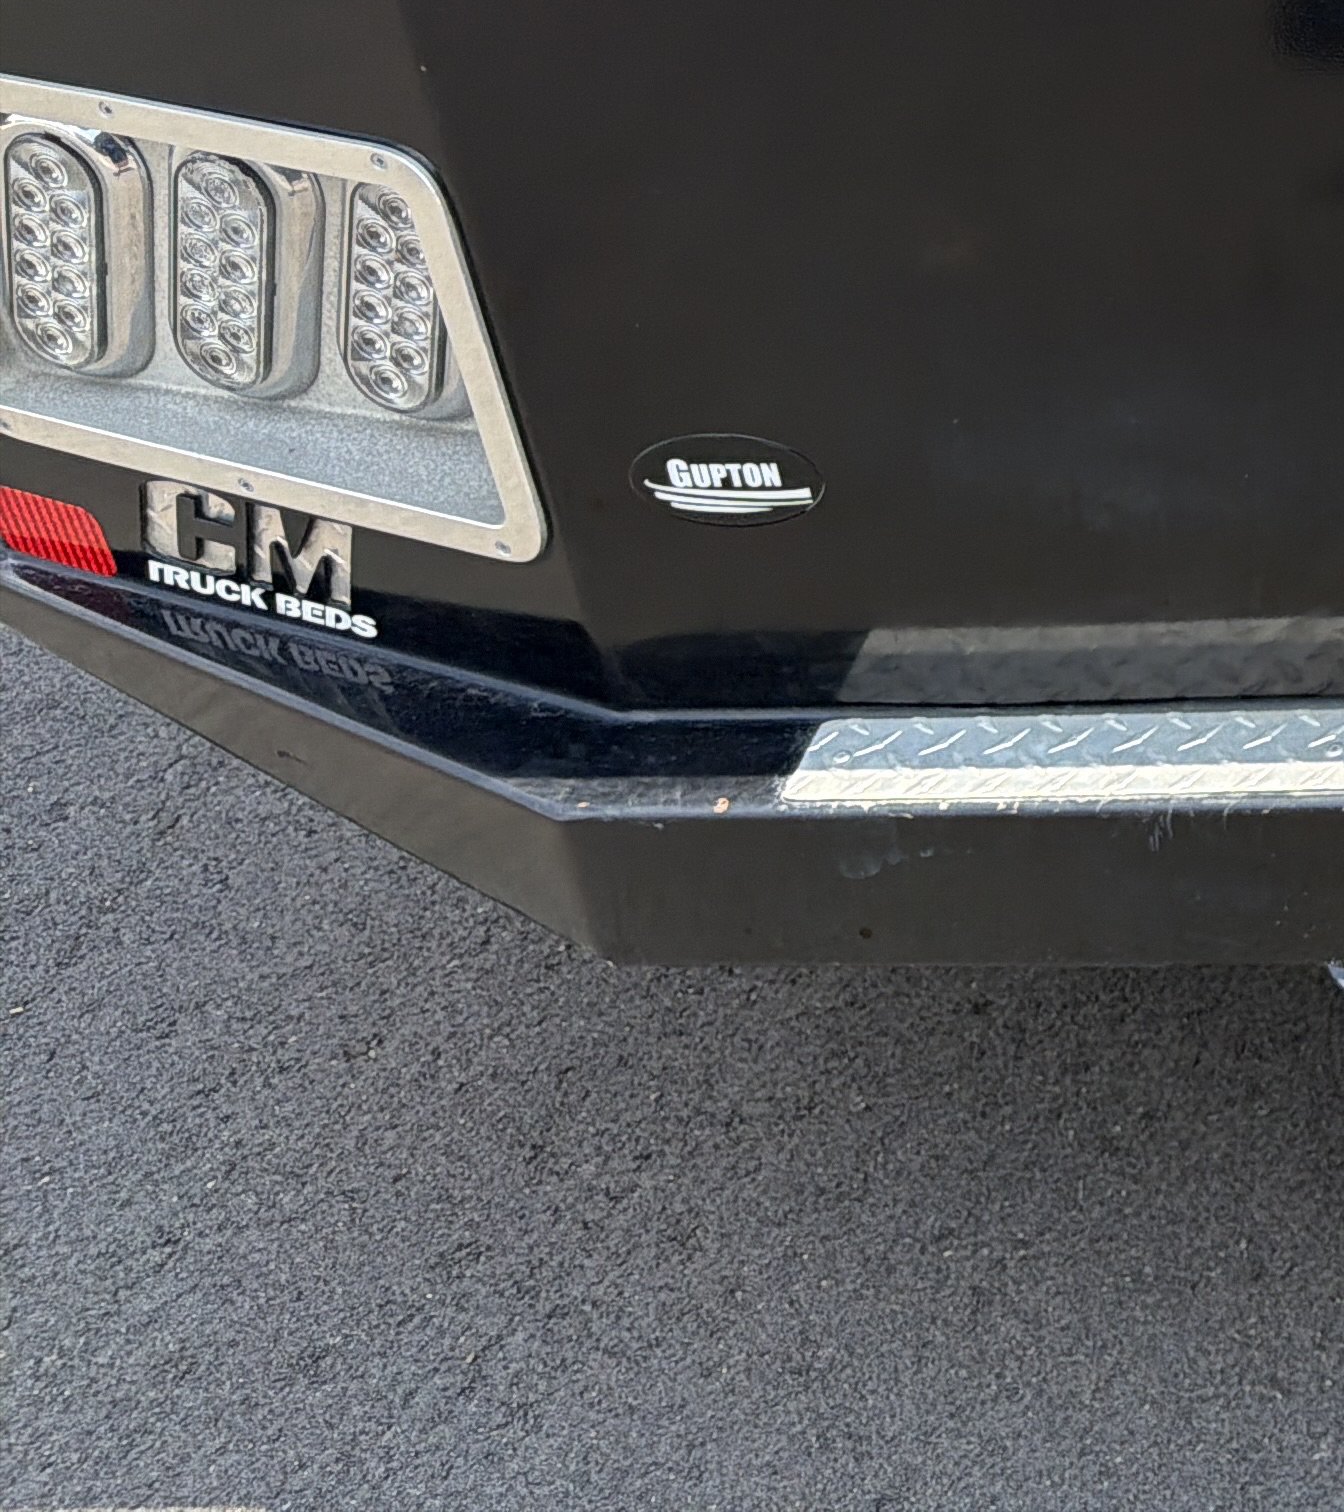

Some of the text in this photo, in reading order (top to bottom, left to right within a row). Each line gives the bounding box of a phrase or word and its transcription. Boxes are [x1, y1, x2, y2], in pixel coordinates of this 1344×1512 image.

[666, 458, 783, 488] GUPTON
[139, 480, 352, 610] CM
[147, 559, 378, 639] TRUCK BEDS
